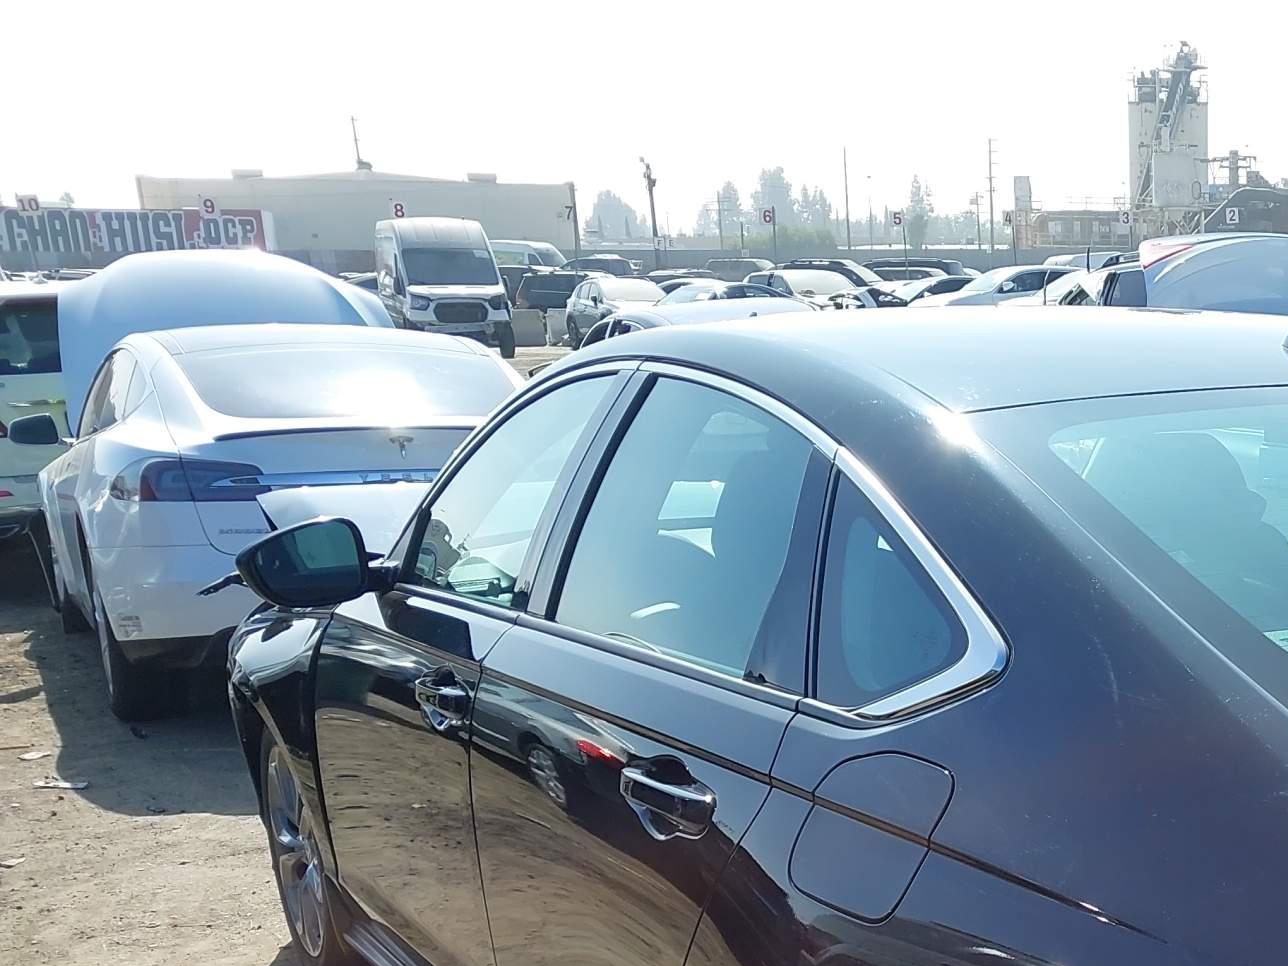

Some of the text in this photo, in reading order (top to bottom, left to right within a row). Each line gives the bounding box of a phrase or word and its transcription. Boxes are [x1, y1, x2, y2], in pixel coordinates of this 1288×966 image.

[18, 198, 40, 212] 10
[203, 198, 215, 214] 9
[393, 203, 405, 218] 8
[564, 205, 574, 220] 7
[762, 209, 773, 224] 6
[892, 211, 902, 225] 5
[1004, 211, 1012, 225] 4
[1122, 211, 1130, 225] 3
[1229, 209, 1237, 222] 2
